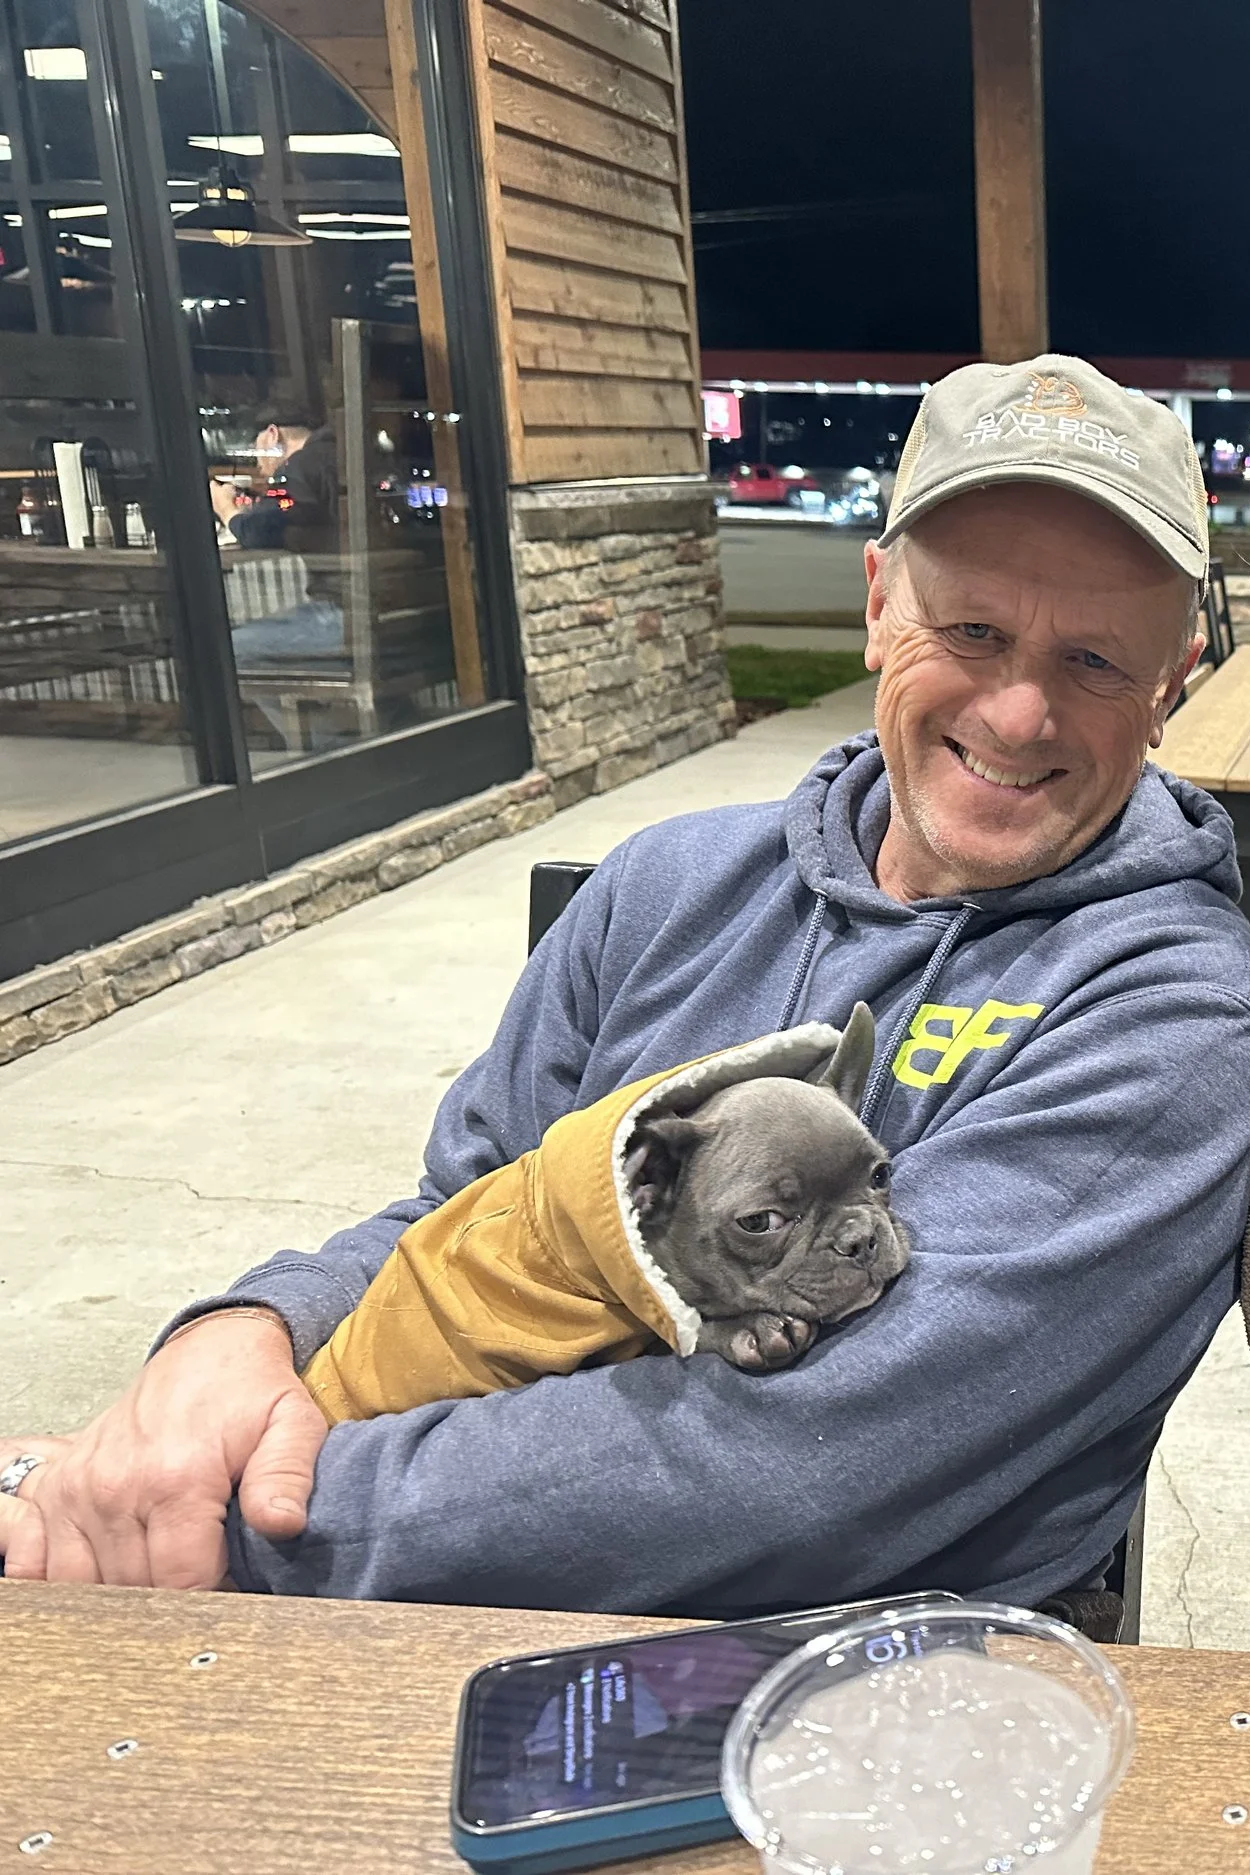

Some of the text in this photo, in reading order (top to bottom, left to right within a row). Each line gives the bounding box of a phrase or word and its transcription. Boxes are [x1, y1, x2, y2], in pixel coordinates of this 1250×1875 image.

[978, 410, 1128, 442] BAD BOY
[962, 427, 1140, 471] TRACTORS
[892, 998, 1046, 1091] BF
